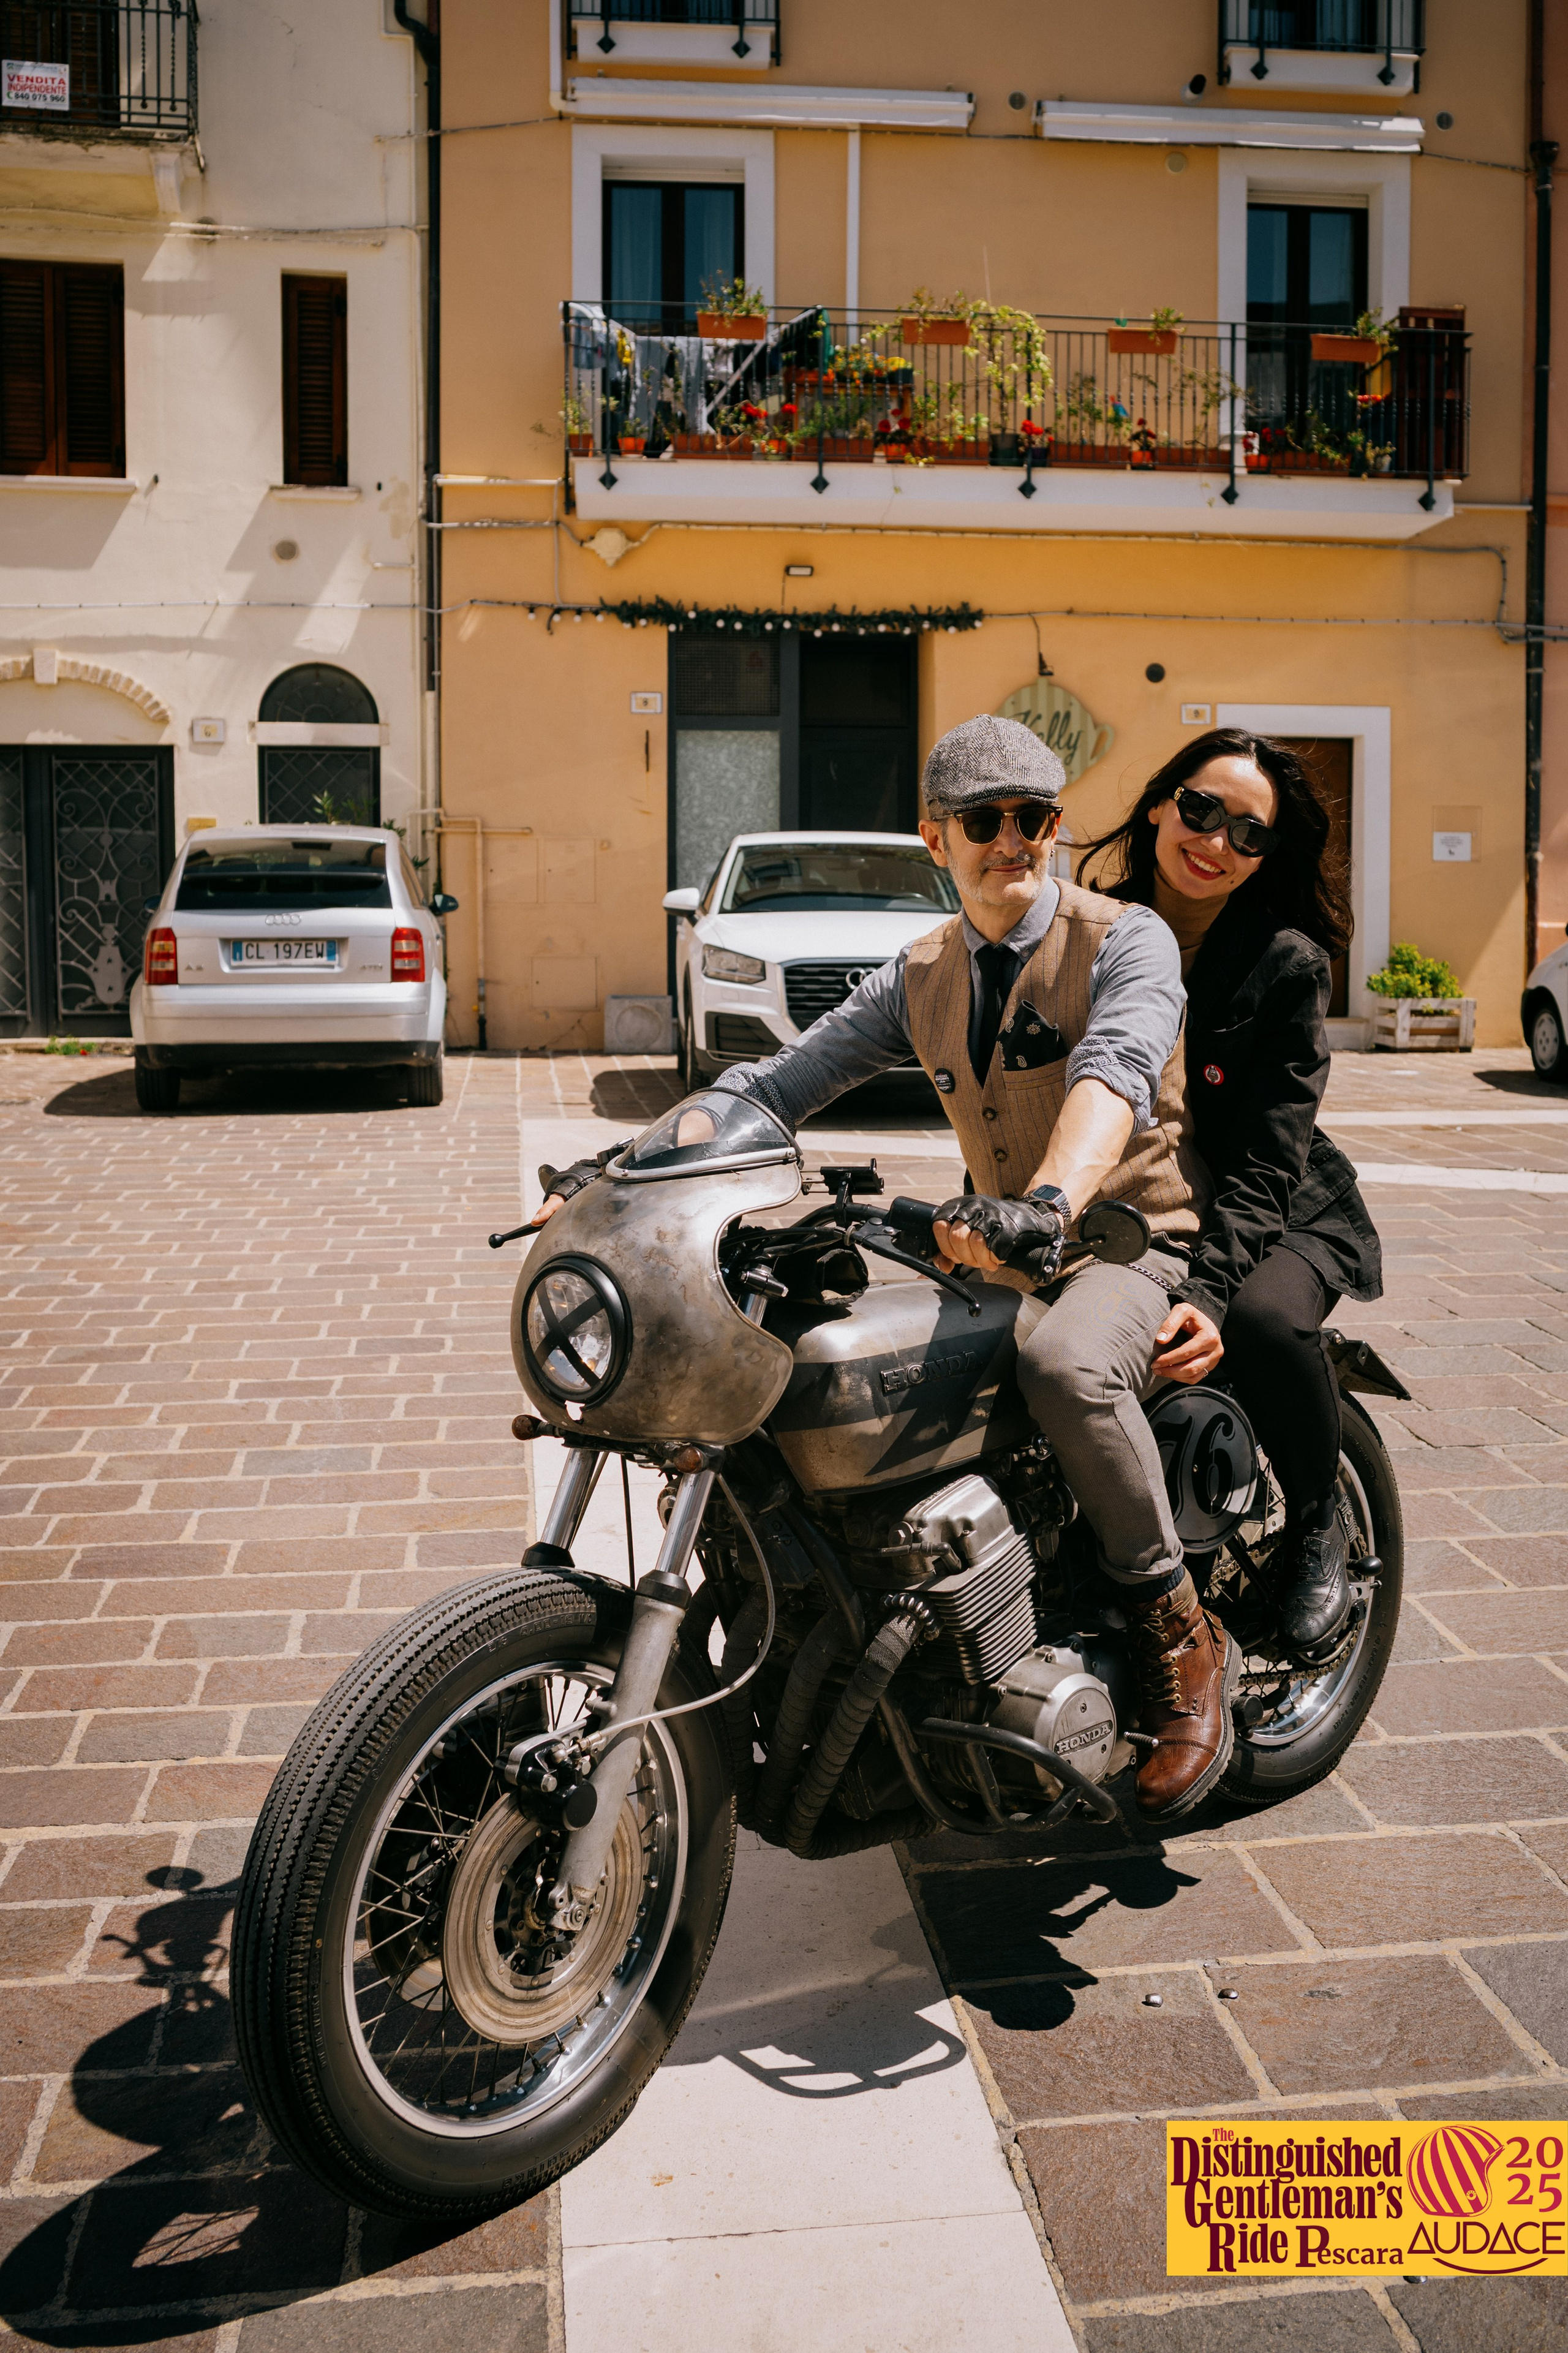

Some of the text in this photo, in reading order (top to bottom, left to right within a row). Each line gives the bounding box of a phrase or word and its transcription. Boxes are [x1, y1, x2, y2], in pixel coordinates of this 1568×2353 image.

[7, 74, 66, 85] VENDITA
[7, 82, 66, 95] INDIPENDENTE
[246, 943, 264, 959] CL
[274, 943, 325, 959] 197EW
[881, 1350, 978, 1395] HONDA
[1056, 1723, 1111, 1754] HONDA
[502, 2146, 570, 2189] SHINKO
